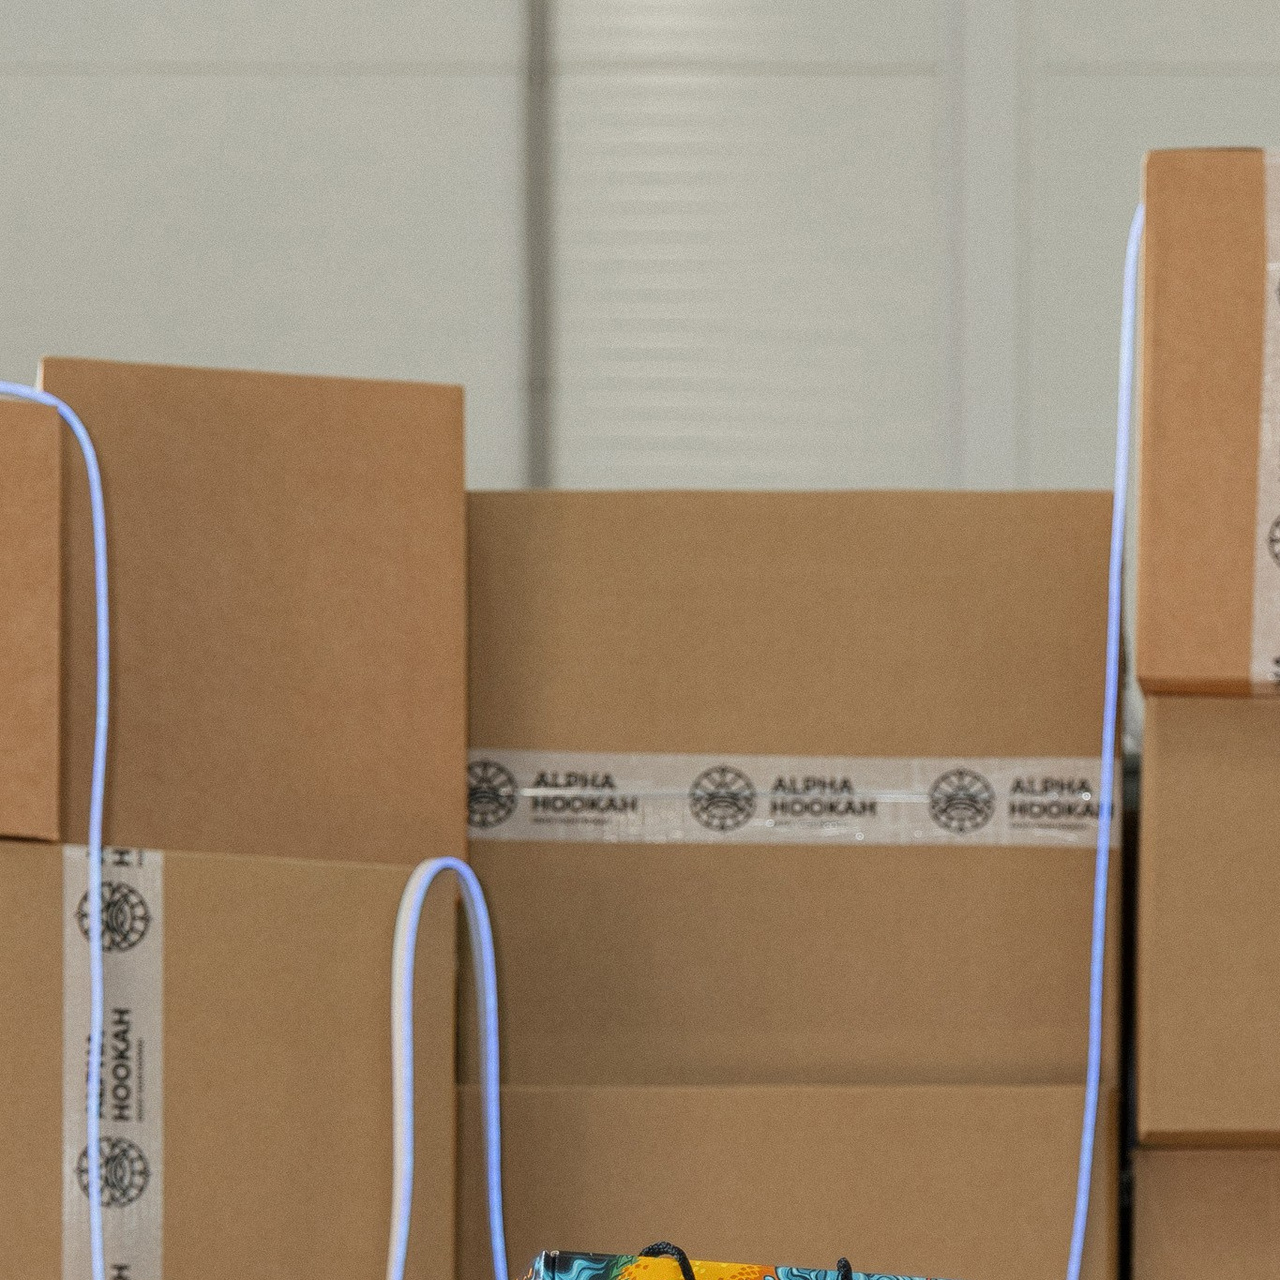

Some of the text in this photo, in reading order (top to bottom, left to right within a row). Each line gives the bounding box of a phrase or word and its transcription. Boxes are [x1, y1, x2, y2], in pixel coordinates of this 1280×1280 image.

[532, 771, 616, 790] ALPHA
[771, 776, 853, 796] ALPHA
[1009, 777, 1092, 797] ALPHA
[532, 795, 637, 816] HOOKAH
[770, 798, 877, 819] HOOKAH
[113, 1007, 132, 1122] HOOKAH
